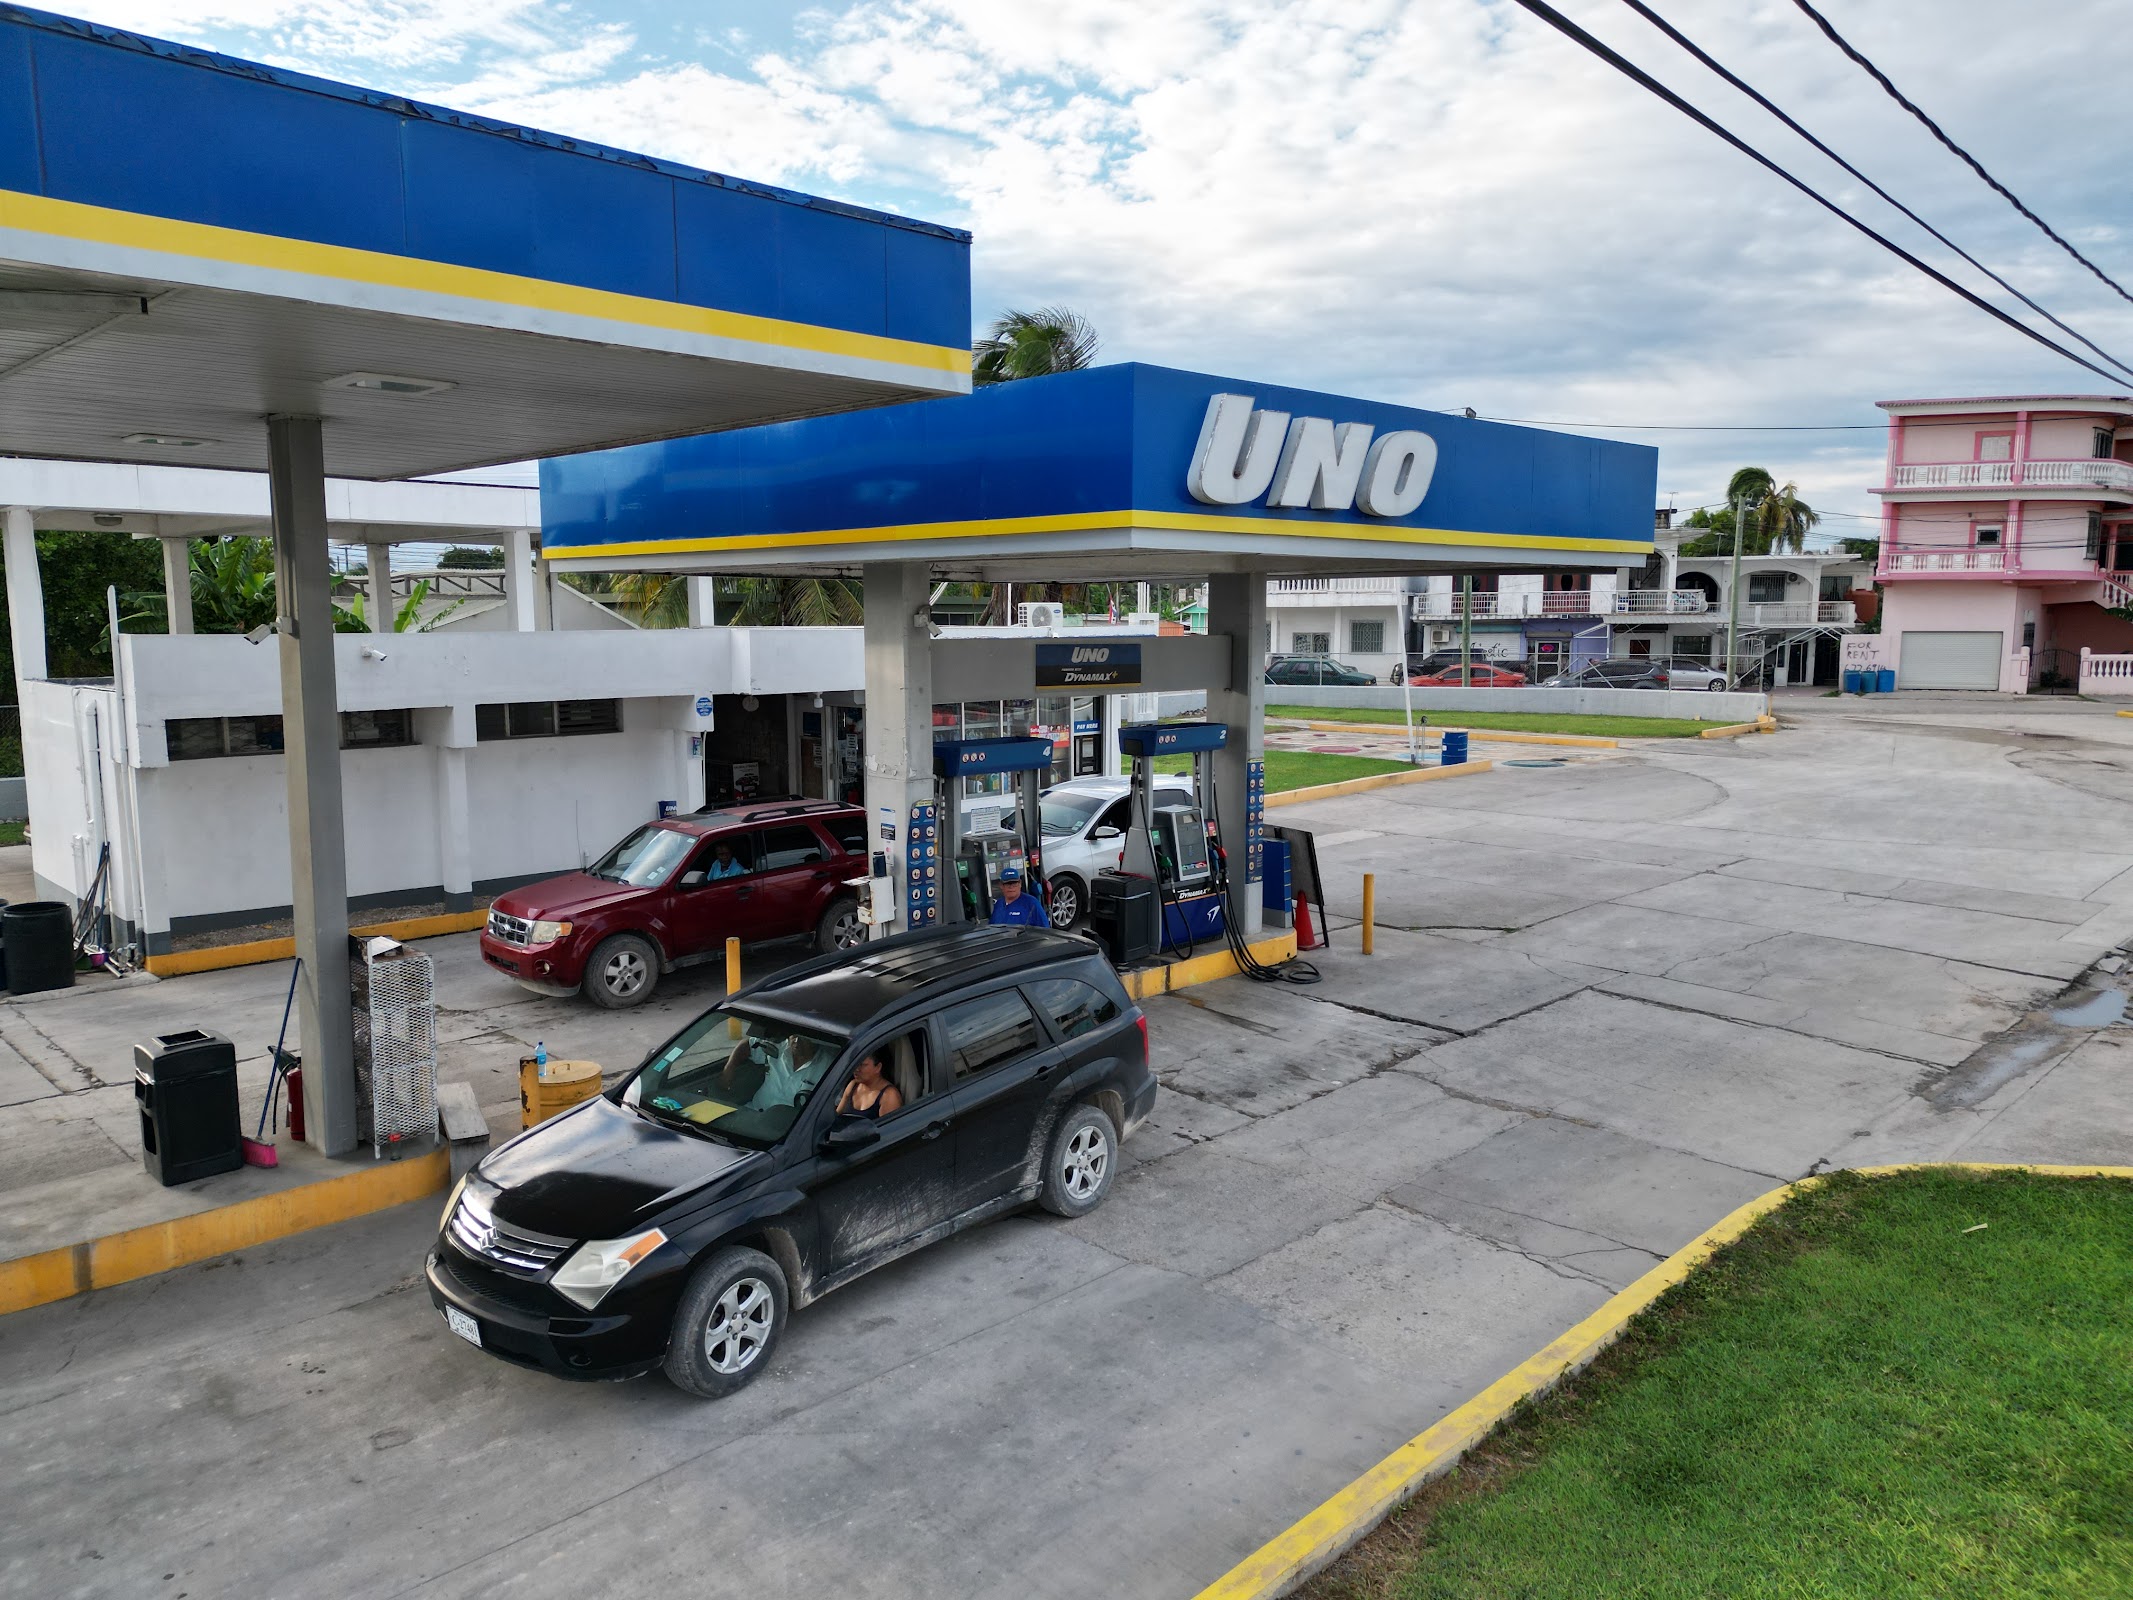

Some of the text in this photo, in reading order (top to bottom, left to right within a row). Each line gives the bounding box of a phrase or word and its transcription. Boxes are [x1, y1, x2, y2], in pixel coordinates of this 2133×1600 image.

[1187, 393, 1438, 516] UNO
[1846, 641, 1871, 650] FOR
[1071, 646, 1110, 663] UNO
[1846, 650, 1880, 660] RENT
[1219, 729, 1227, 739] 2
[1042, 746, 1051, 757] 4
